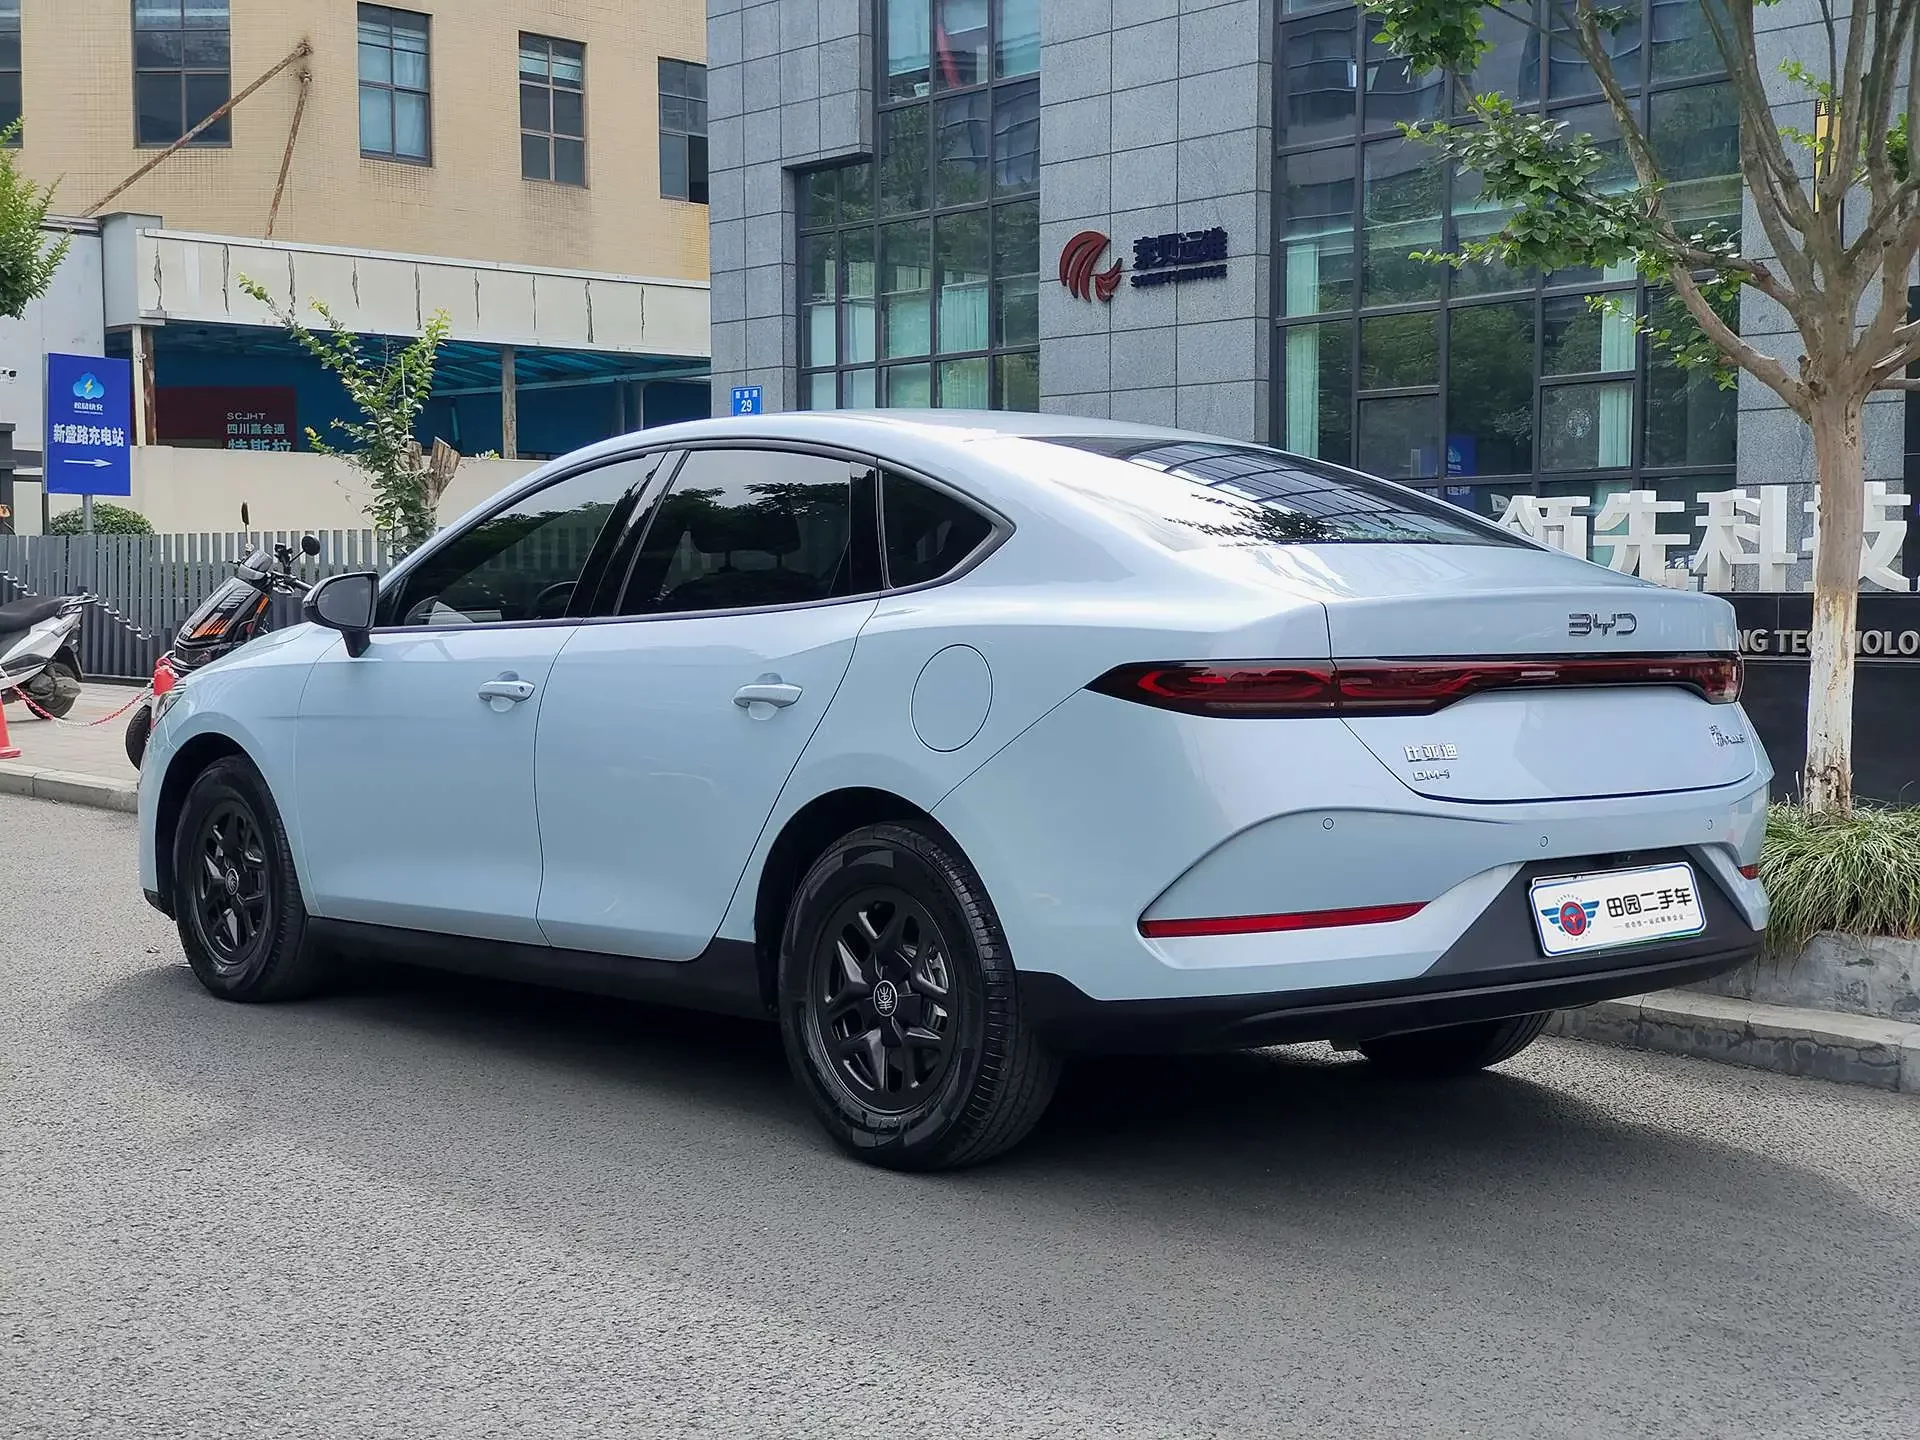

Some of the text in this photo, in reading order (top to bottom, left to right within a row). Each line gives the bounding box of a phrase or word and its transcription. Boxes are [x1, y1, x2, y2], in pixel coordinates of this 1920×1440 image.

[741, 400, 752, 412] 29
[53, 423, 124, 447] 新盛路充电站
[1568, 613, 1637, 636] BYD
[1404, 743, 1458, 762] 比亚迪
[1606, 887, 1693, 918] 田园二手车
